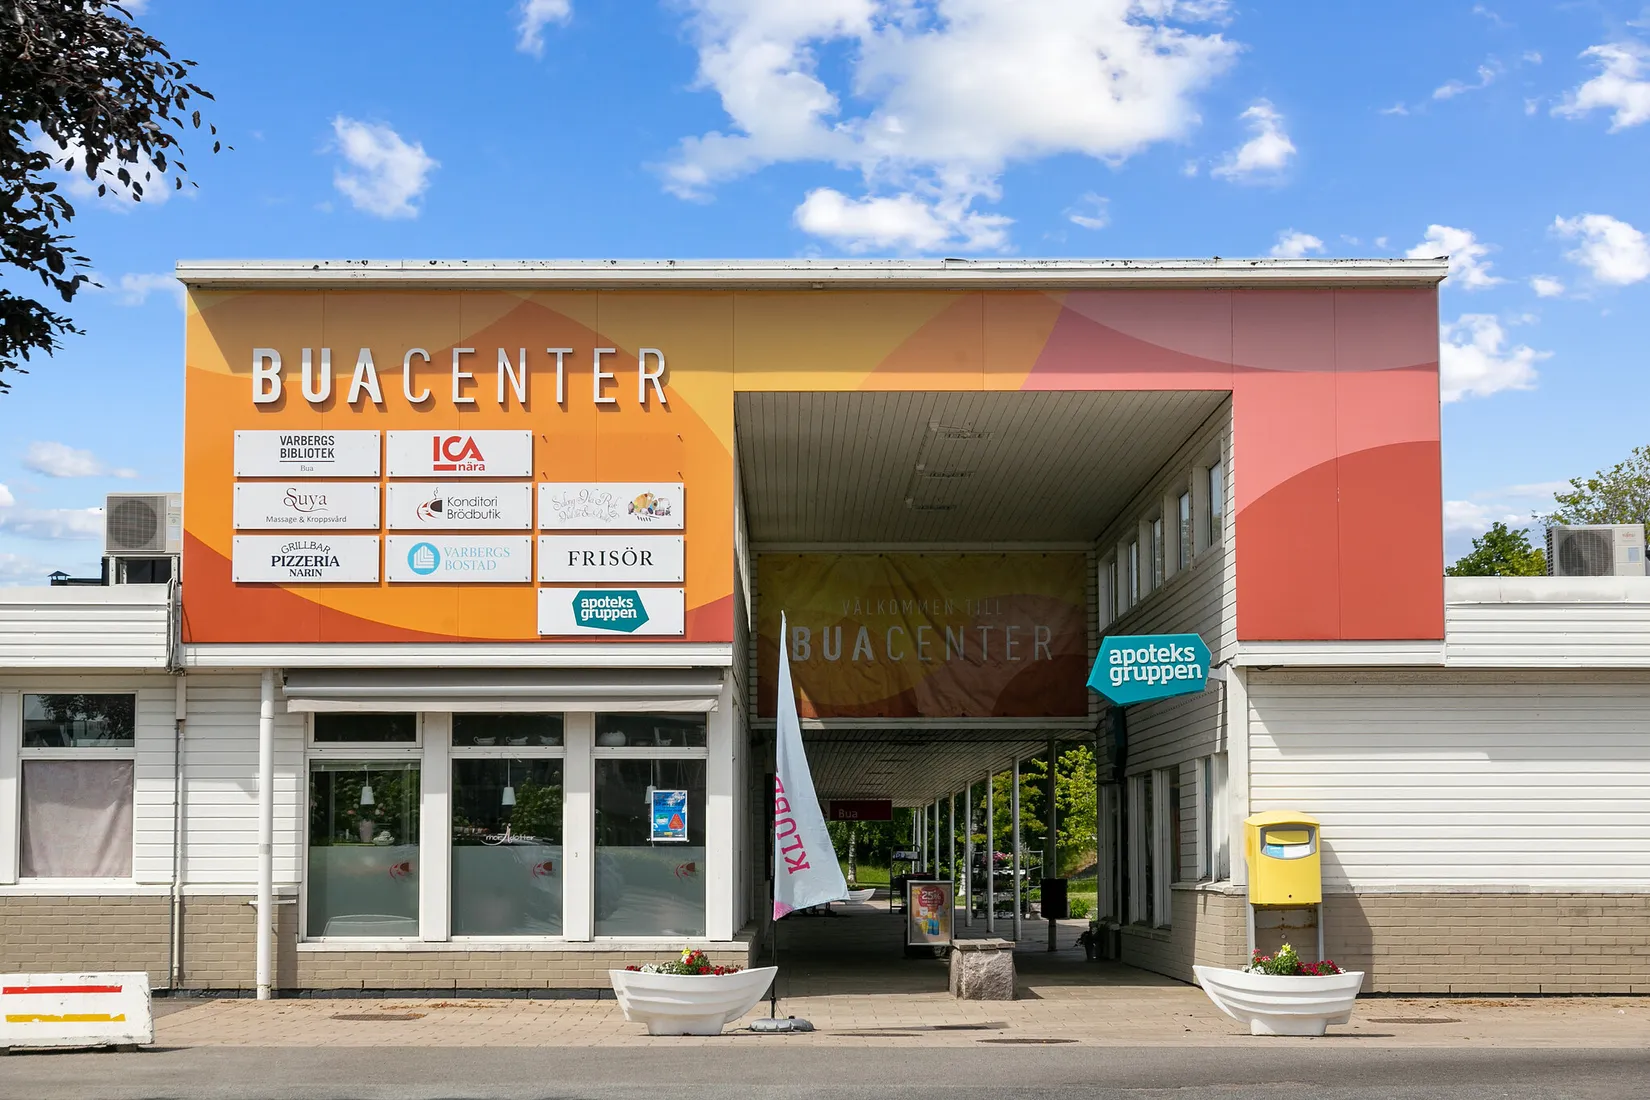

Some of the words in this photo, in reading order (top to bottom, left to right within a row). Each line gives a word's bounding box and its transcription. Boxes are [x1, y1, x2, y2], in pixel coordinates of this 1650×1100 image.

[279, 435, 335, 446] VARBERGS
[279, 447, 335, 459] BIBLIOTEK
[433, 435, 485, 462] ICA
[300, 464, 314, 472] Bua
[458, 461, 486, 472] nära
[283, 487, 328, 513] Suya
[447, 496, 498, 507] Konditori
[265, 515, 298, 524] Massage
[306, 515, 347, 524] Kroppsvård
[447, 508, 501, 520] Brödbutik
[280, 540, 331, 555] GRILLBAR
[444, 546, 510, 558] VARBERGS
[270, 555, 341, 568] PIZZERIA
[567, 546, 654, 567] FRISÖR
[444, 560, 497, 571] BOSTAD
[289, 568, 323, 578] NARIN
[581, 595, 634, 610] apoteks
[966, 597, 1004, 616] TILL
[580, 608, 638, 621] gruppen
[1109, 643, 1196, 666] apoteks
[1109, 663, 1203, 687] gruppen
[838, 808, 859, 819] Bua
